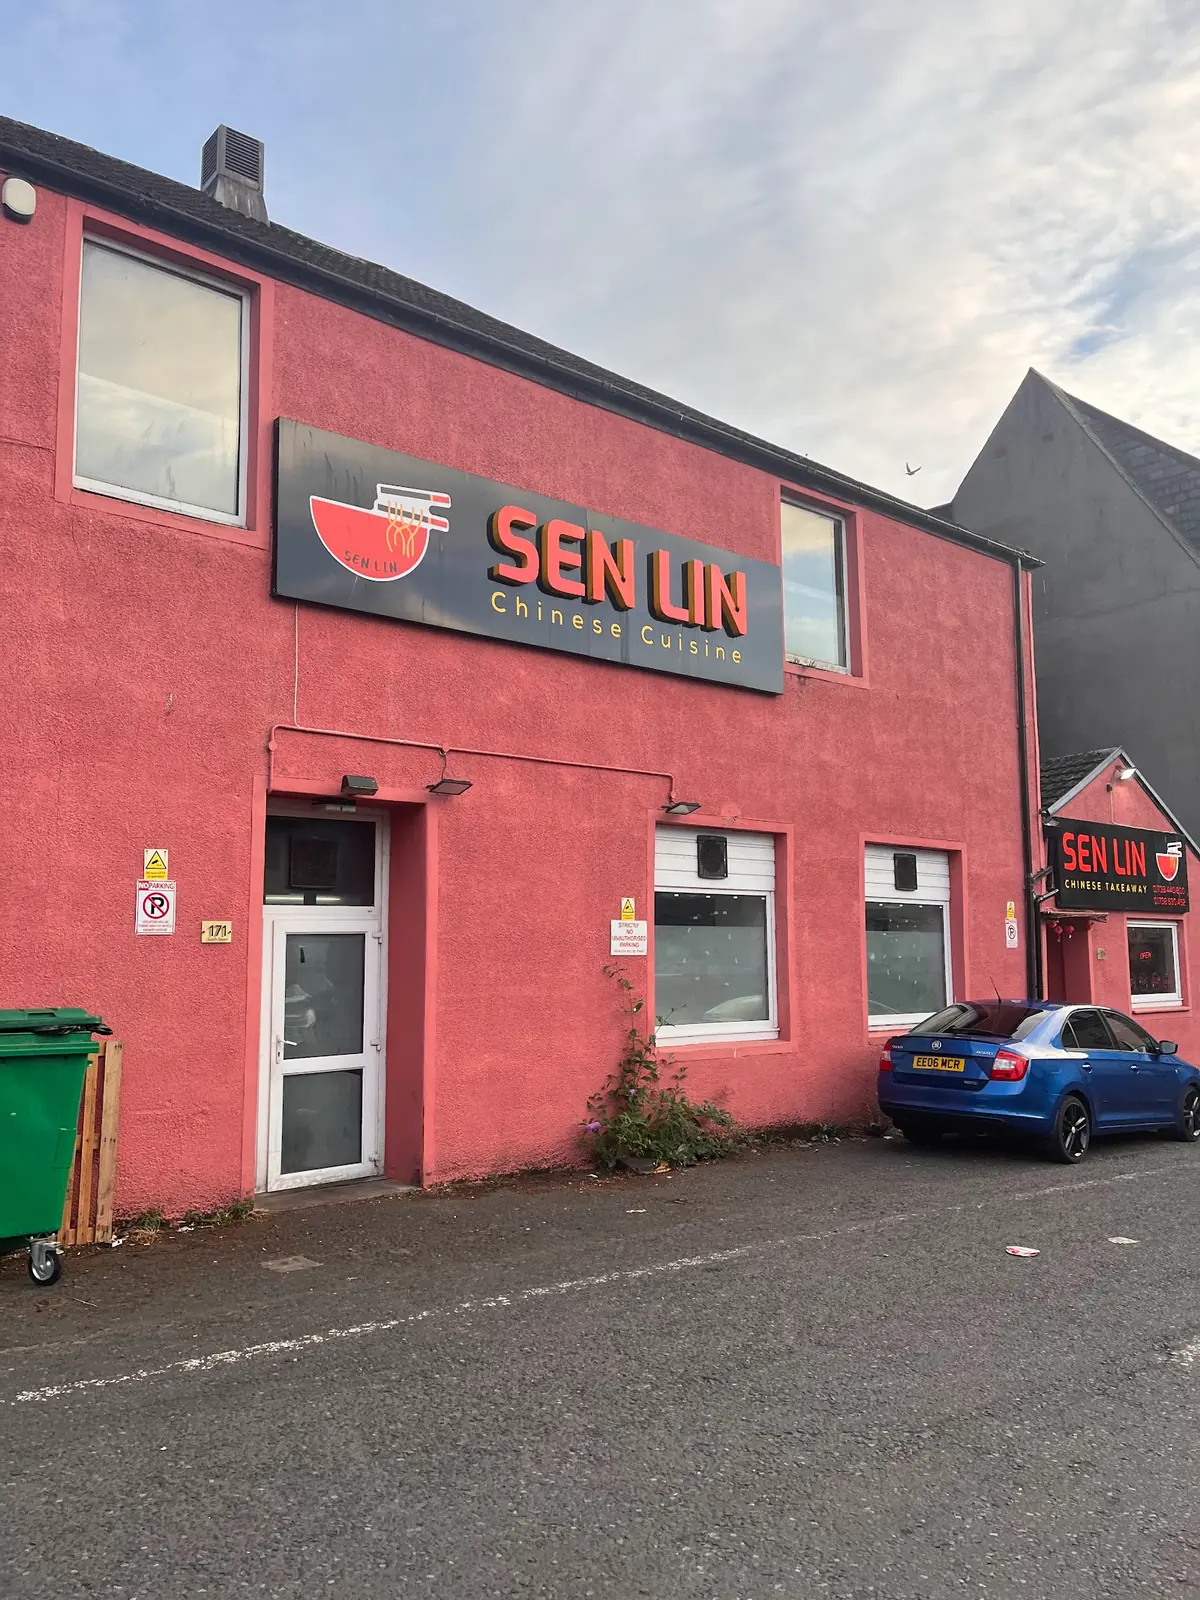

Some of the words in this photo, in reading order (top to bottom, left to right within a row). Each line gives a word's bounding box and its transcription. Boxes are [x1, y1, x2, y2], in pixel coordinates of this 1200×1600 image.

[344, 550, 369, 569] SEN
[374, 560, 397, 573] LIN
[488, 505, 635, 611] SEN
[648, 549, 747, 637] LIN
[491, 591, 622, 638] Chinese
[641, 625, 742, 664] Cuisine
[1062, 832, 1107, 874] SEN
[1113, 838, 1146, 877] LIN
[139, 881, 149, 890] NO
[148, 881, 174, 890] PARKING
[1064, 879, 1102, 891] CHINESE
[1105, 882, 1148, 894] TAKEAWAY
[207, 924, 227, 938] 171
[916, 1057, 939, 1068] EE06
[940, 1059, 961, 1070] MCR
